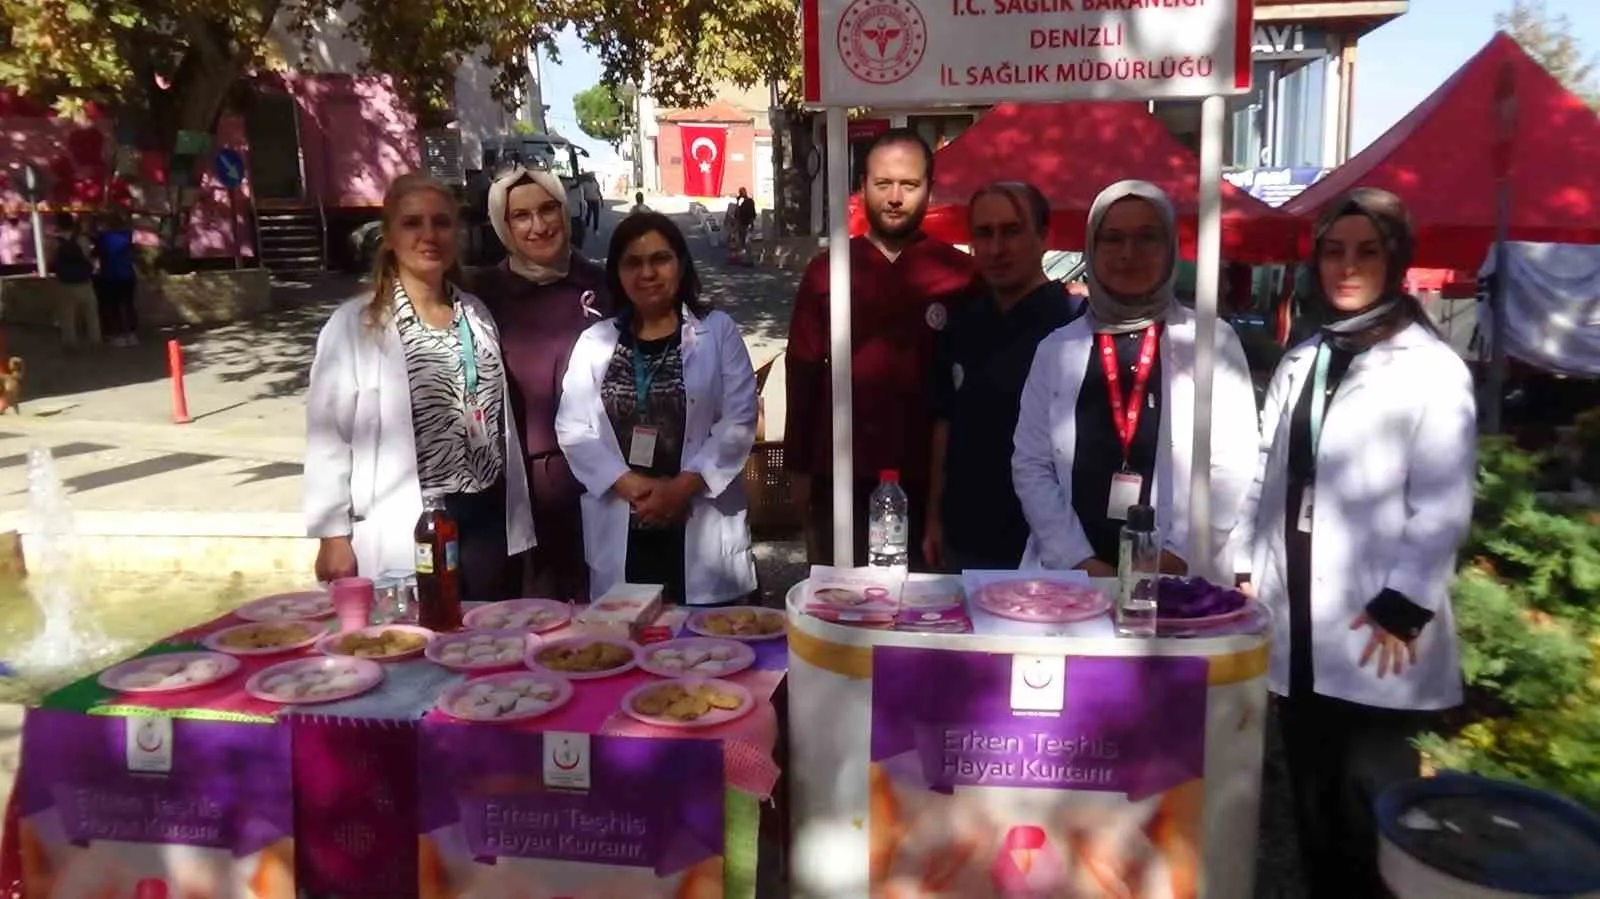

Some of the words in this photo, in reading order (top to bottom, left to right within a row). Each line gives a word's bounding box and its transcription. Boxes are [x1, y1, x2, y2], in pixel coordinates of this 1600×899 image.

[1030, 23, 1121, 49] DENİZLİ
[940, 62, 960, 87] İL
[966, 60, 1049, 86] SAĞLIK
[1056, 55, 1213, 82] MÜDÜRLÜĞÜ
[943, 728, 1024, 754] Erken
[942, 754, 1016, 784] Hayat
